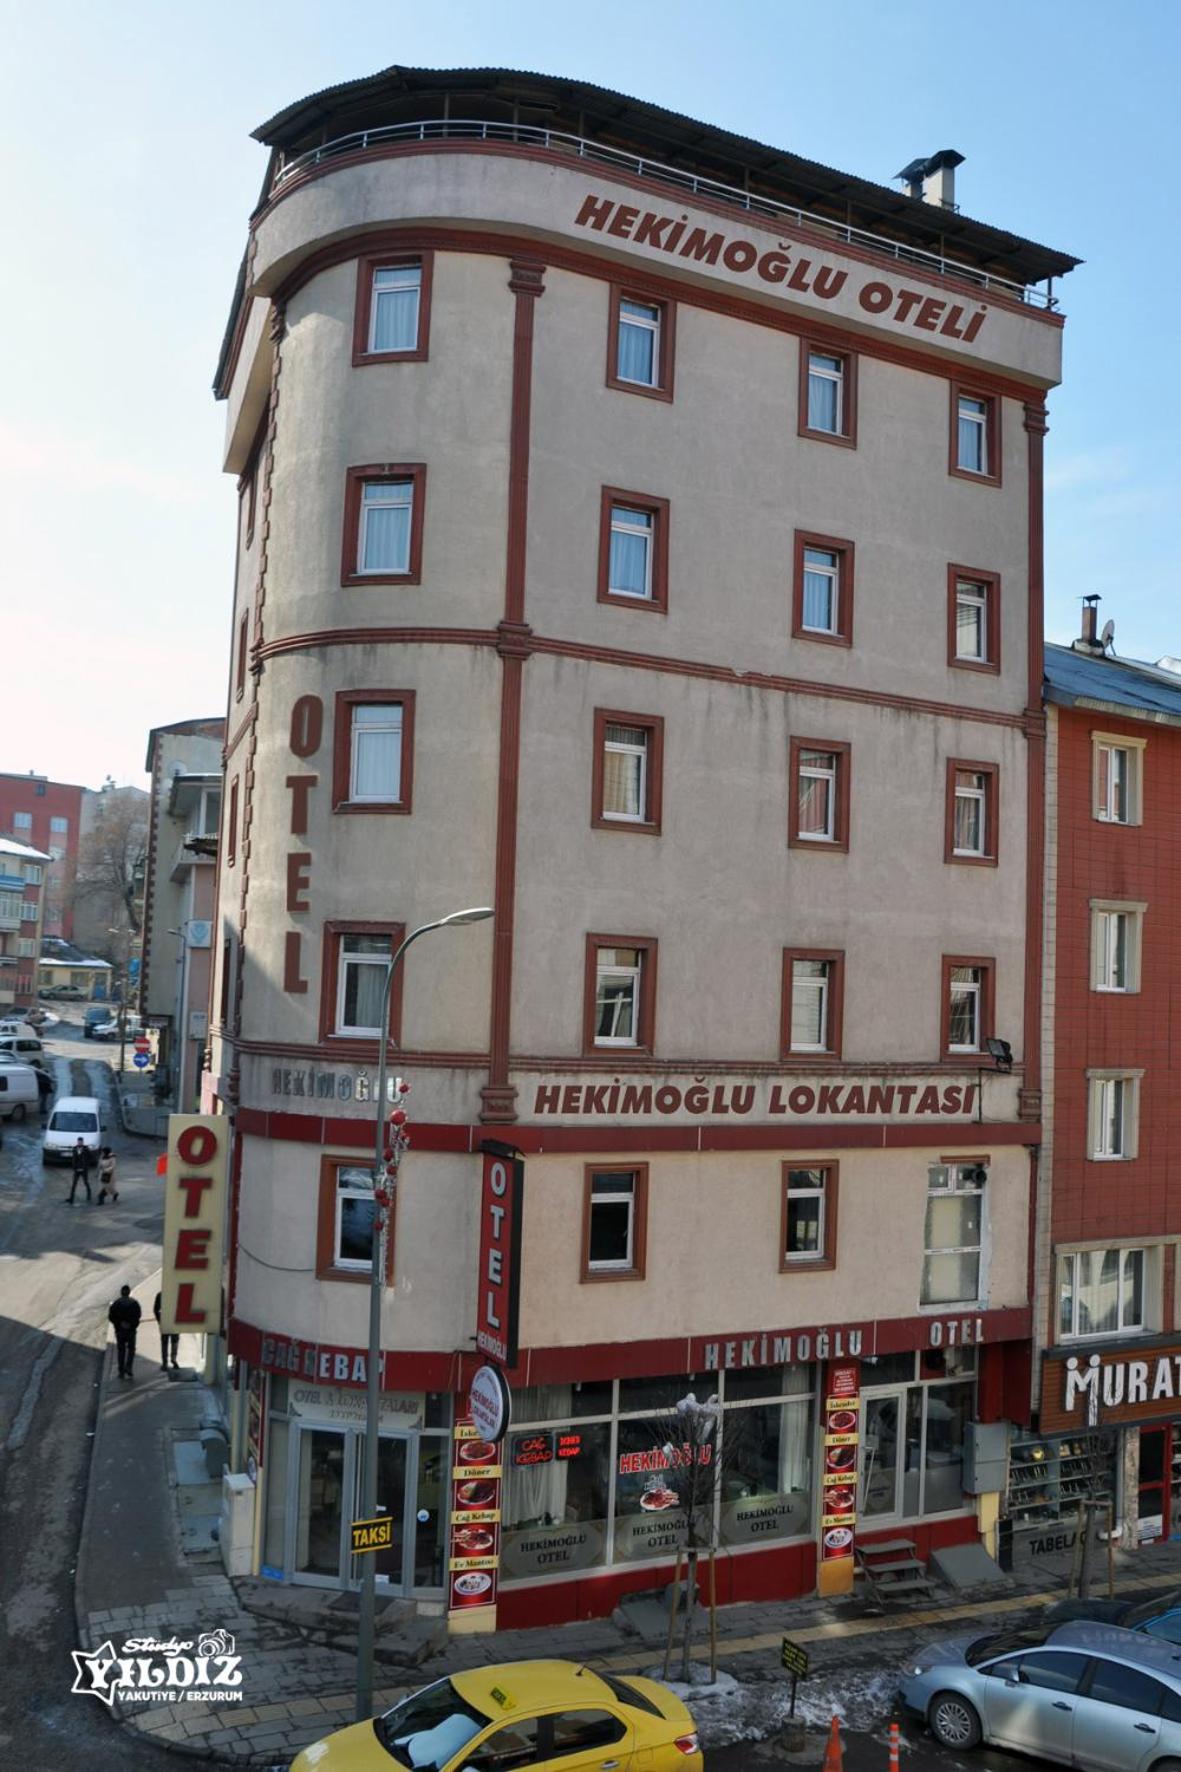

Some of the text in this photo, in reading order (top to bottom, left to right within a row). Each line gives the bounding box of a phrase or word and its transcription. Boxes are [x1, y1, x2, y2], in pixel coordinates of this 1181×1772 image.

[574, 194, 988, 343] HEKİMOĞLU OTELİ
[283, 694, 324, 994] OTEL
[534, 1076, 977, 1115] HEKİMOĞLU LOKANTASI
[174, 1125, 217, 1325] OTEL
[486, 1161, 507, 1329] OTEL
[705, 1318, 984, 1371] HEKİMOĞLU OTEL
[294, 1388, 322, 1405] OTEL
[619, 1441, 712, 1475] HEKİMOĞU
[736, 1504, 795, 1522] HEKİMOĞLU
[750, 1518, 780, 1533] OTEL
[352, 1521, 392, 1547] TAKSİ
[520, 1533, 588, 1553] HEKİMOĞLU
[646, 1533, 679, 1549] OTEL
[536, 1550, 571, 1565] OTEL
